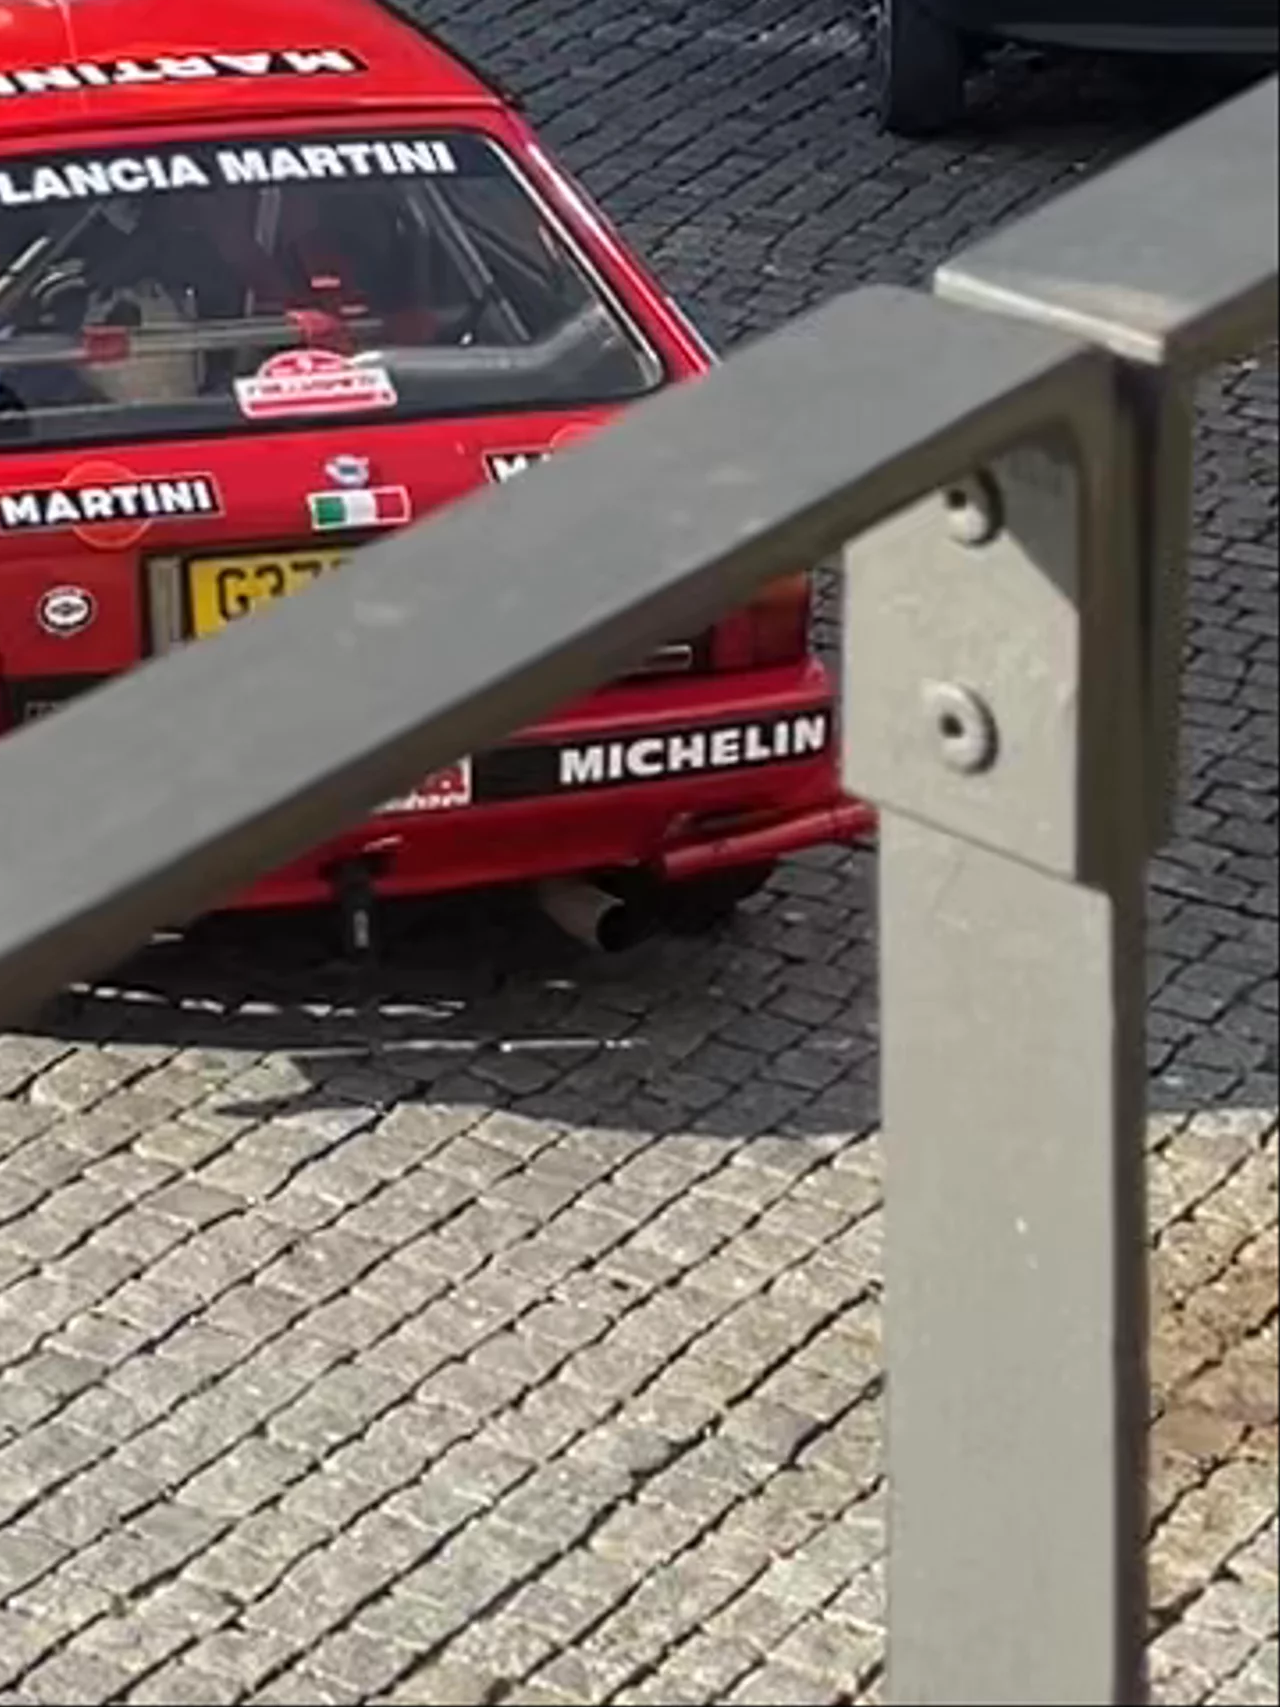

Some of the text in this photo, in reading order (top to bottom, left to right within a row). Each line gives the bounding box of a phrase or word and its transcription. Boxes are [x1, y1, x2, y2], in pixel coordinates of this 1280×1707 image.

[218, 140, 456, 183] MARTINI
[0, 480, 213, 526] MARTINI
[559, 715, 826, 784] MICHELIN
